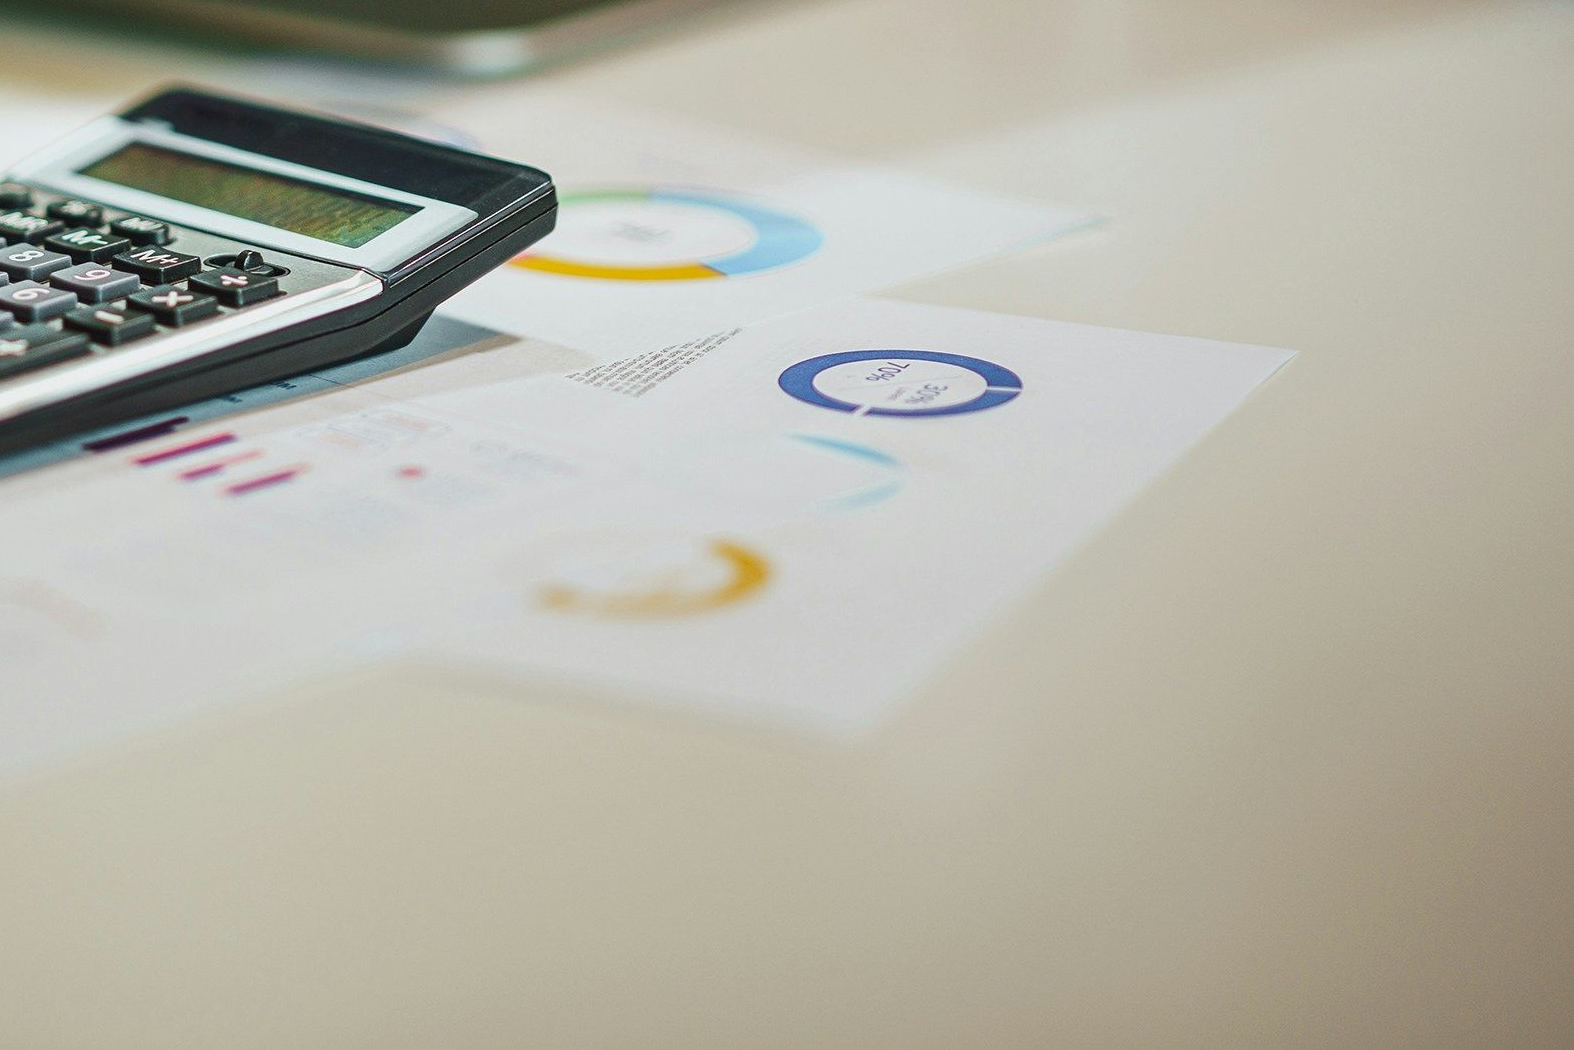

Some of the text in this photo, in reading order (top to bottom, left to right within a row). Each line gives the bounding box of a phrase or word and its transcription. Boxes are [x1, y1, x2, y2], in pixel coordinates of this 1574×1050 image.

[8, 250, 44, 262] 8
[130, 249, 178, 265] M+
[74, 269, 111, 281] 9
[12, 288, 50, 301] 6
[865, 361, 910, 381] 70%
